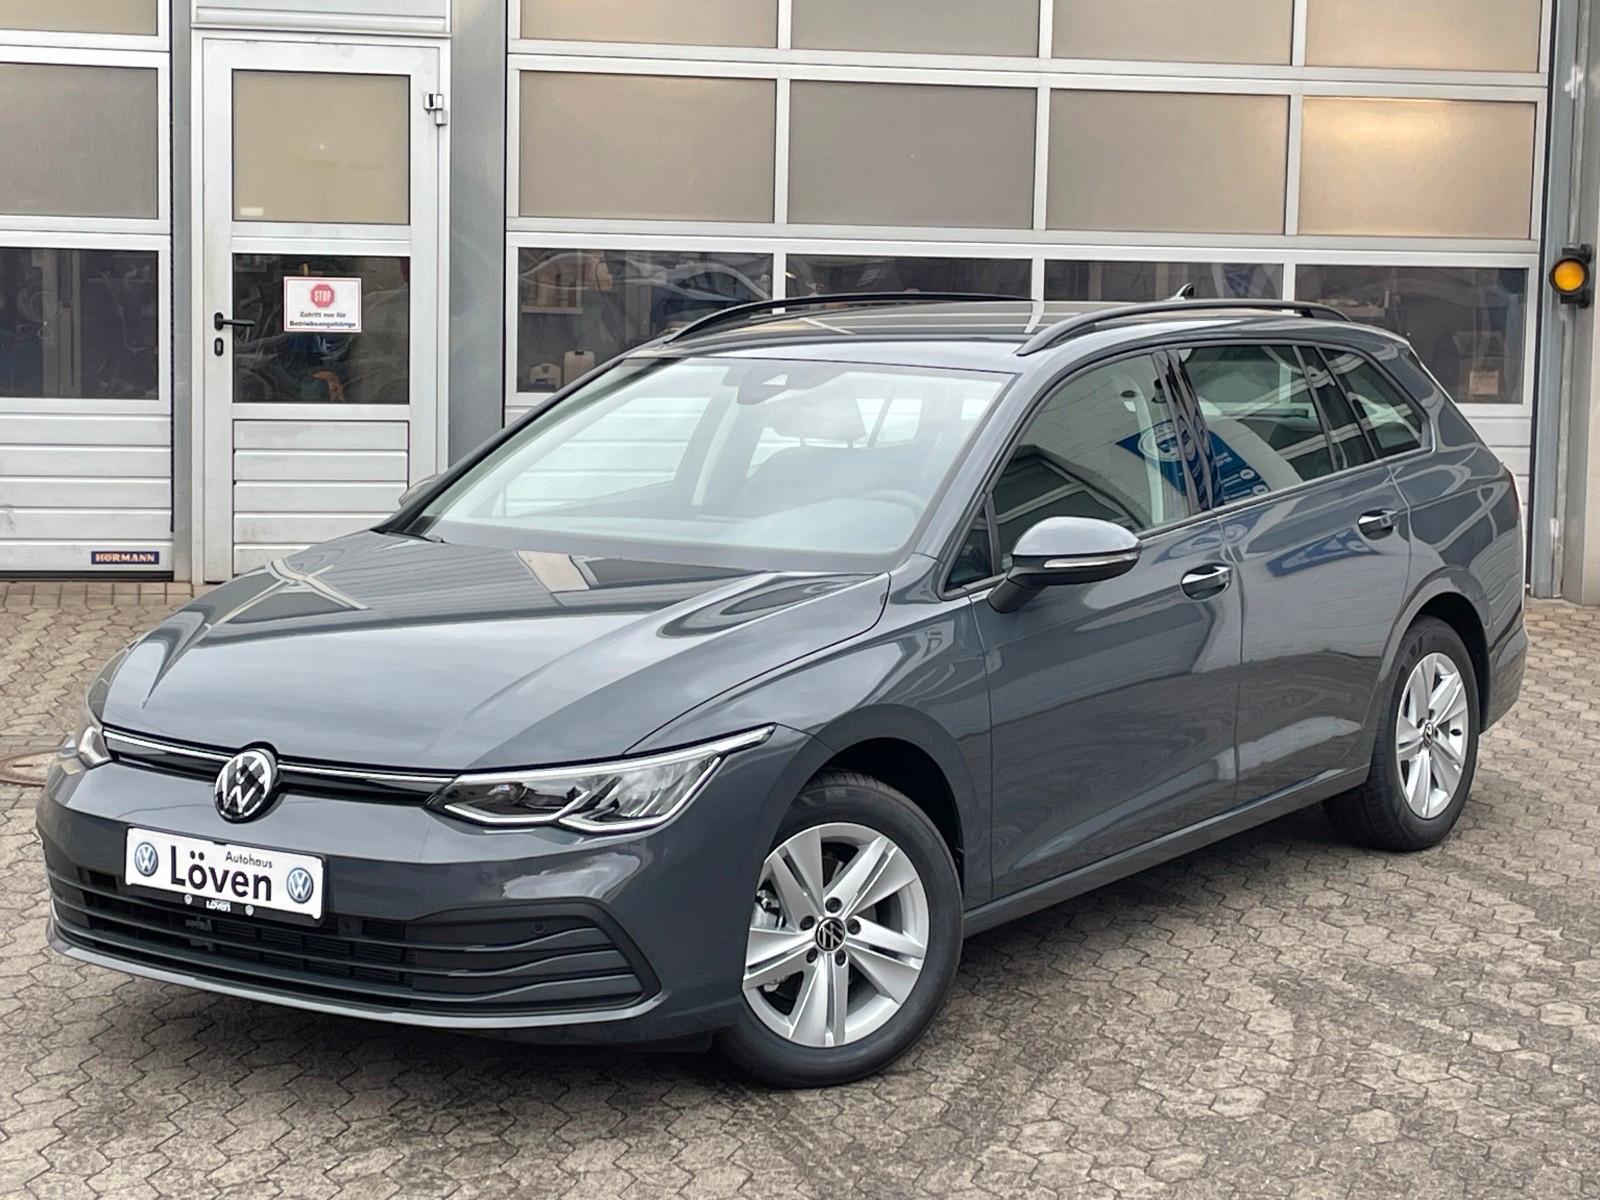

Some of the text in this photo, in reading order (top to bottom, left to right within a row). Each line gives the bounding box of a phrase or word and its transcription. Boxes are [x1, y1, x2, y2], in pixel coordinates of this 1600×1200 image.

[314, 290, 332, 302] STOP
[225, 850, 273, 869] Autohaus
[170, 845, 272, 901] Löven
